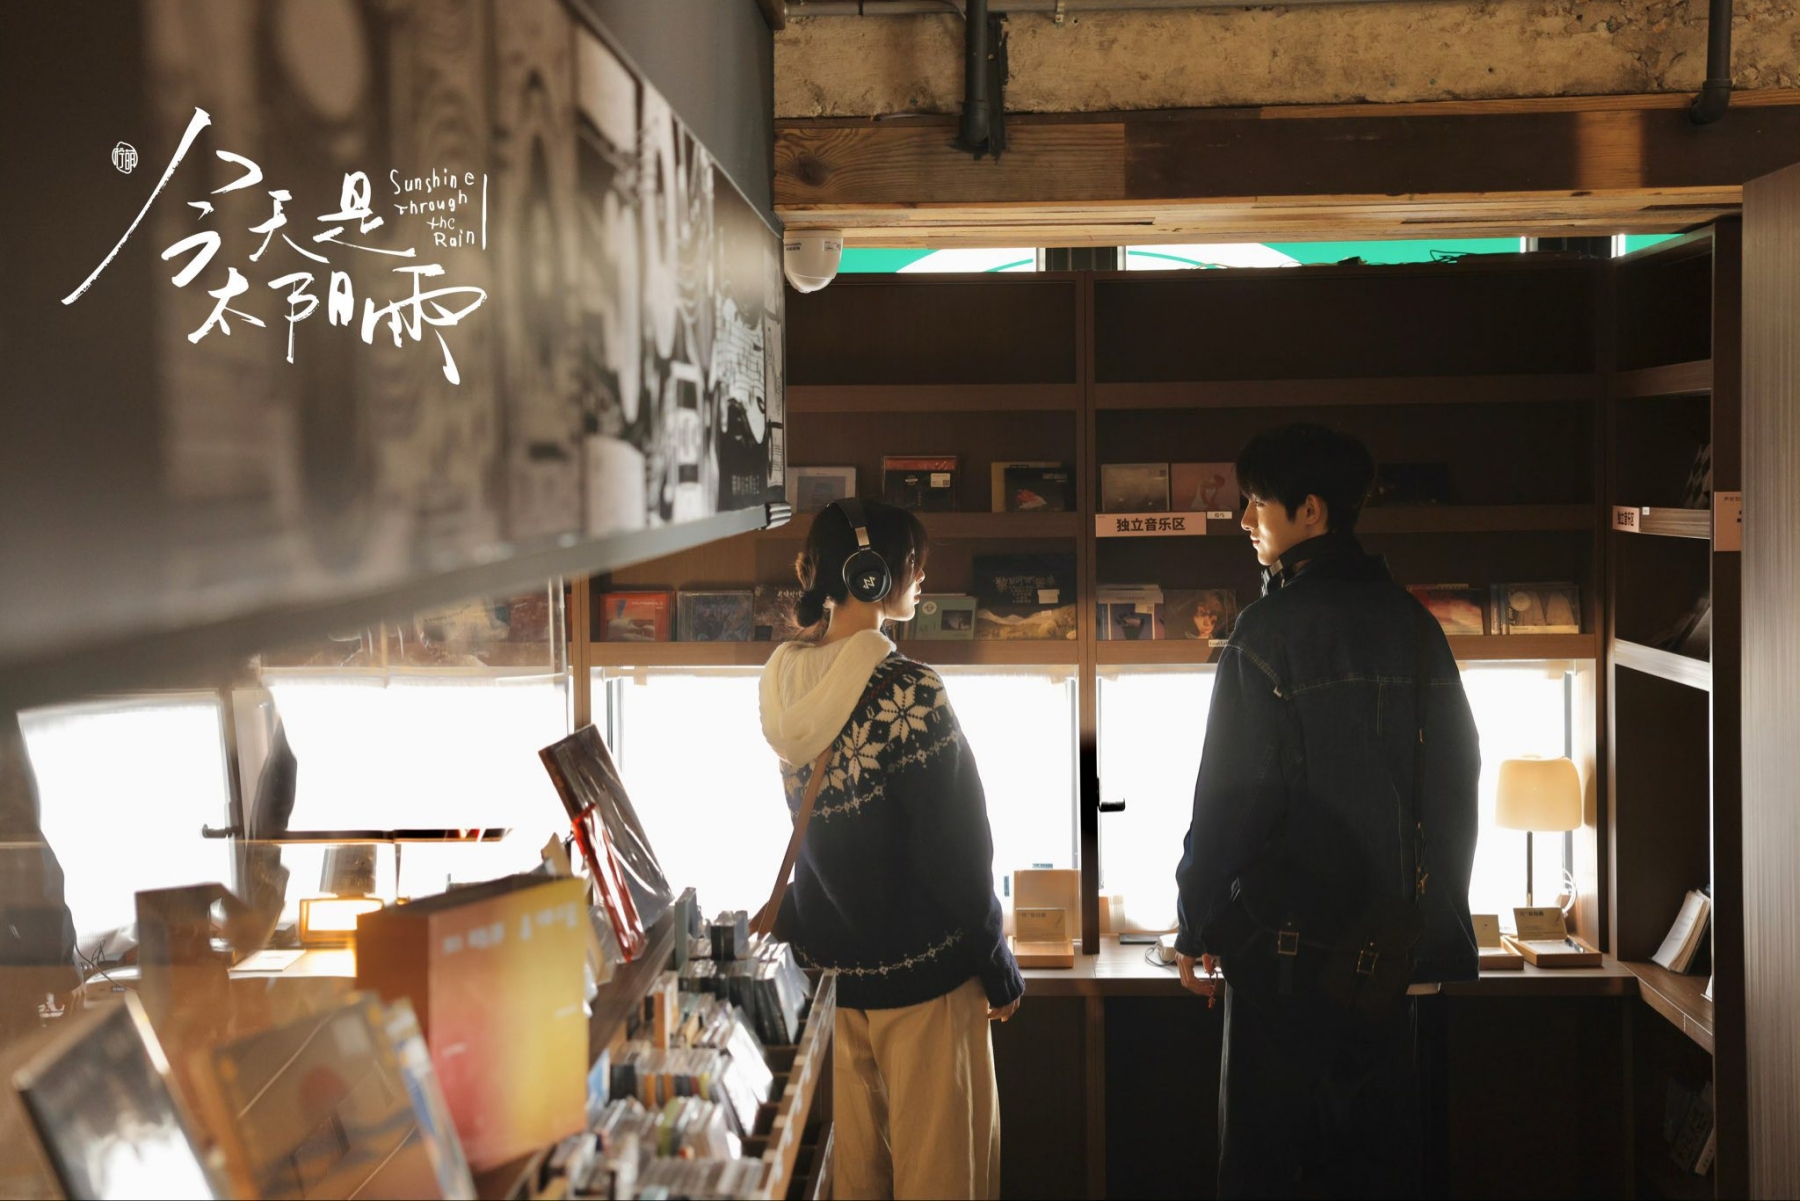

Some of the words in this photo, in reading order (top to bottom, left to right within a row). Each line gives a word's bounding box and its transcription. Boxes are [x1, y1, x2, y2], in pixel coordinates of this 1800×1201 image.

[1116, 517, 1185, 532] 独立音乐区
